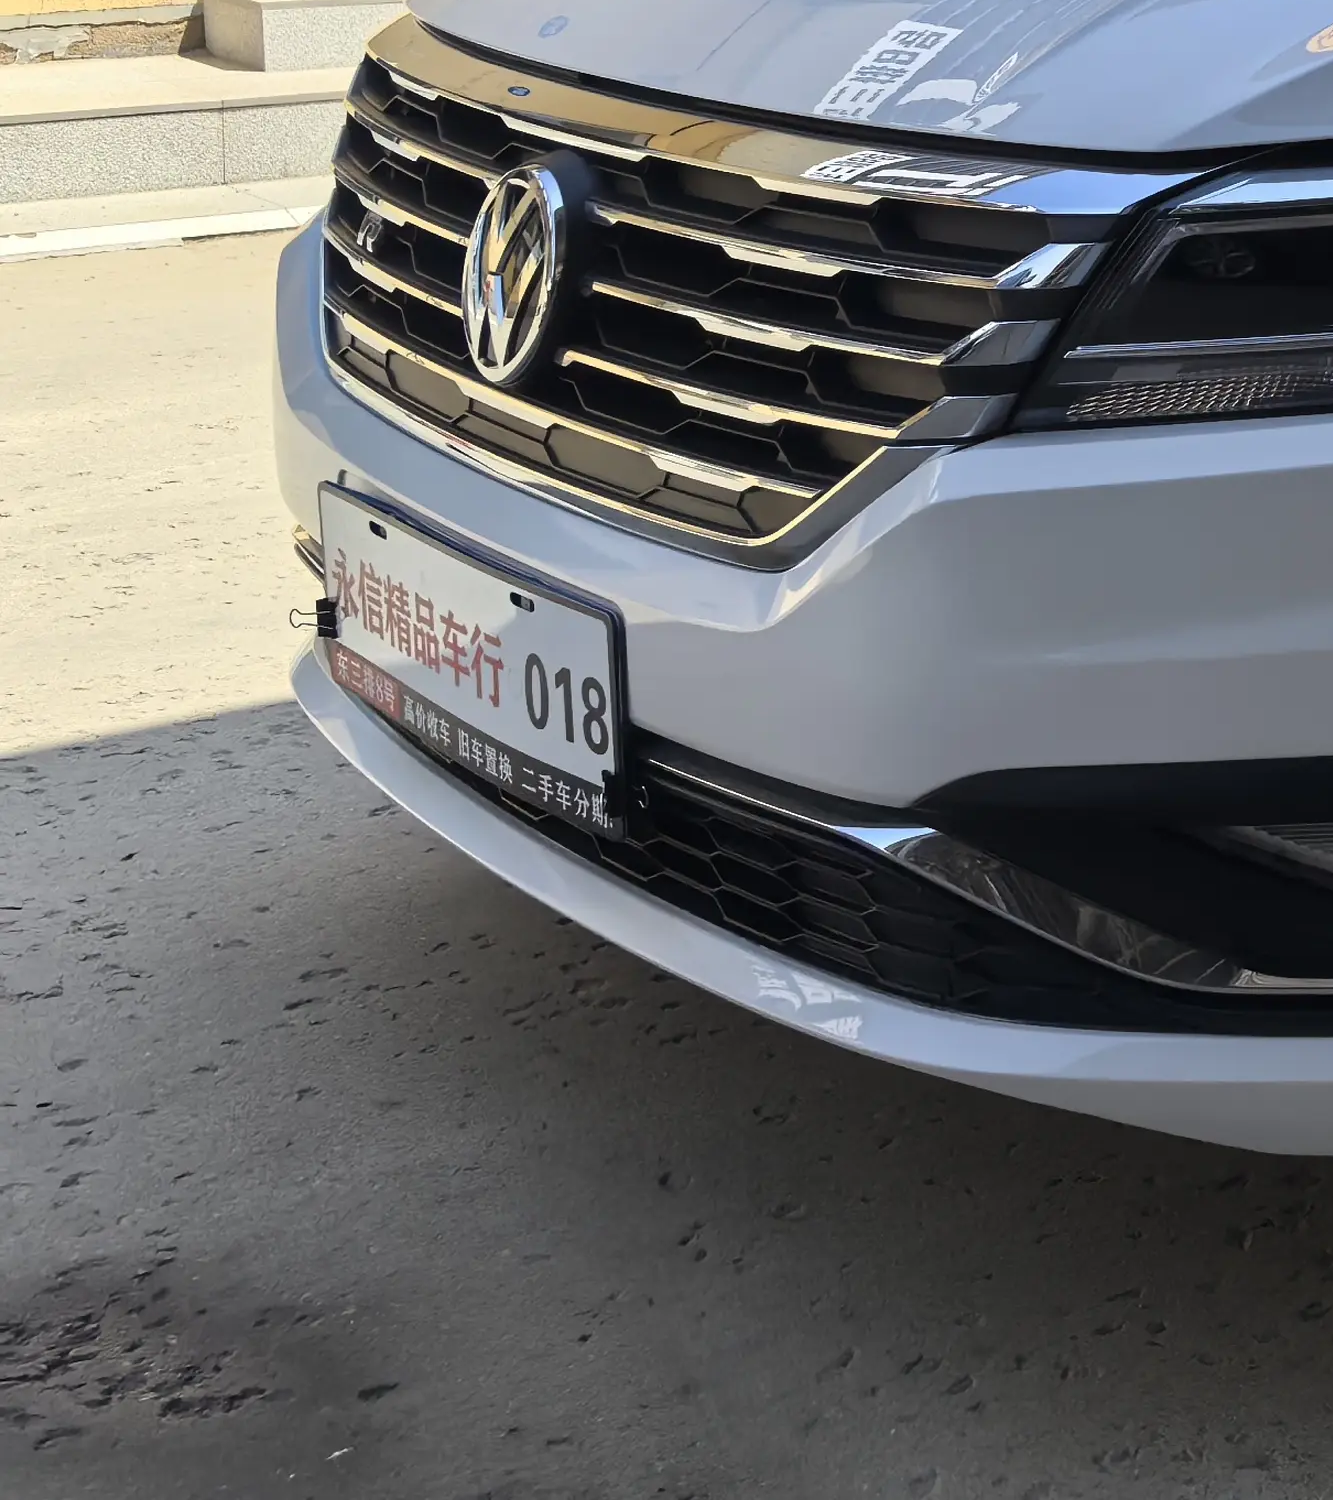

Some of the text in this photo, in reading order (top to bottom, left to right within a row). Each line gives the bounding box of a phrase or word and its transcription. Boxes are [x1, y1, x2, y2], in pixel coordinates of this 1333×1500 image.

[331, 547, 610, 756] 永信精品车行 018
[403, 694, 452, 748] 高价收车
[457, 728, 515, 786] 旧车置换
